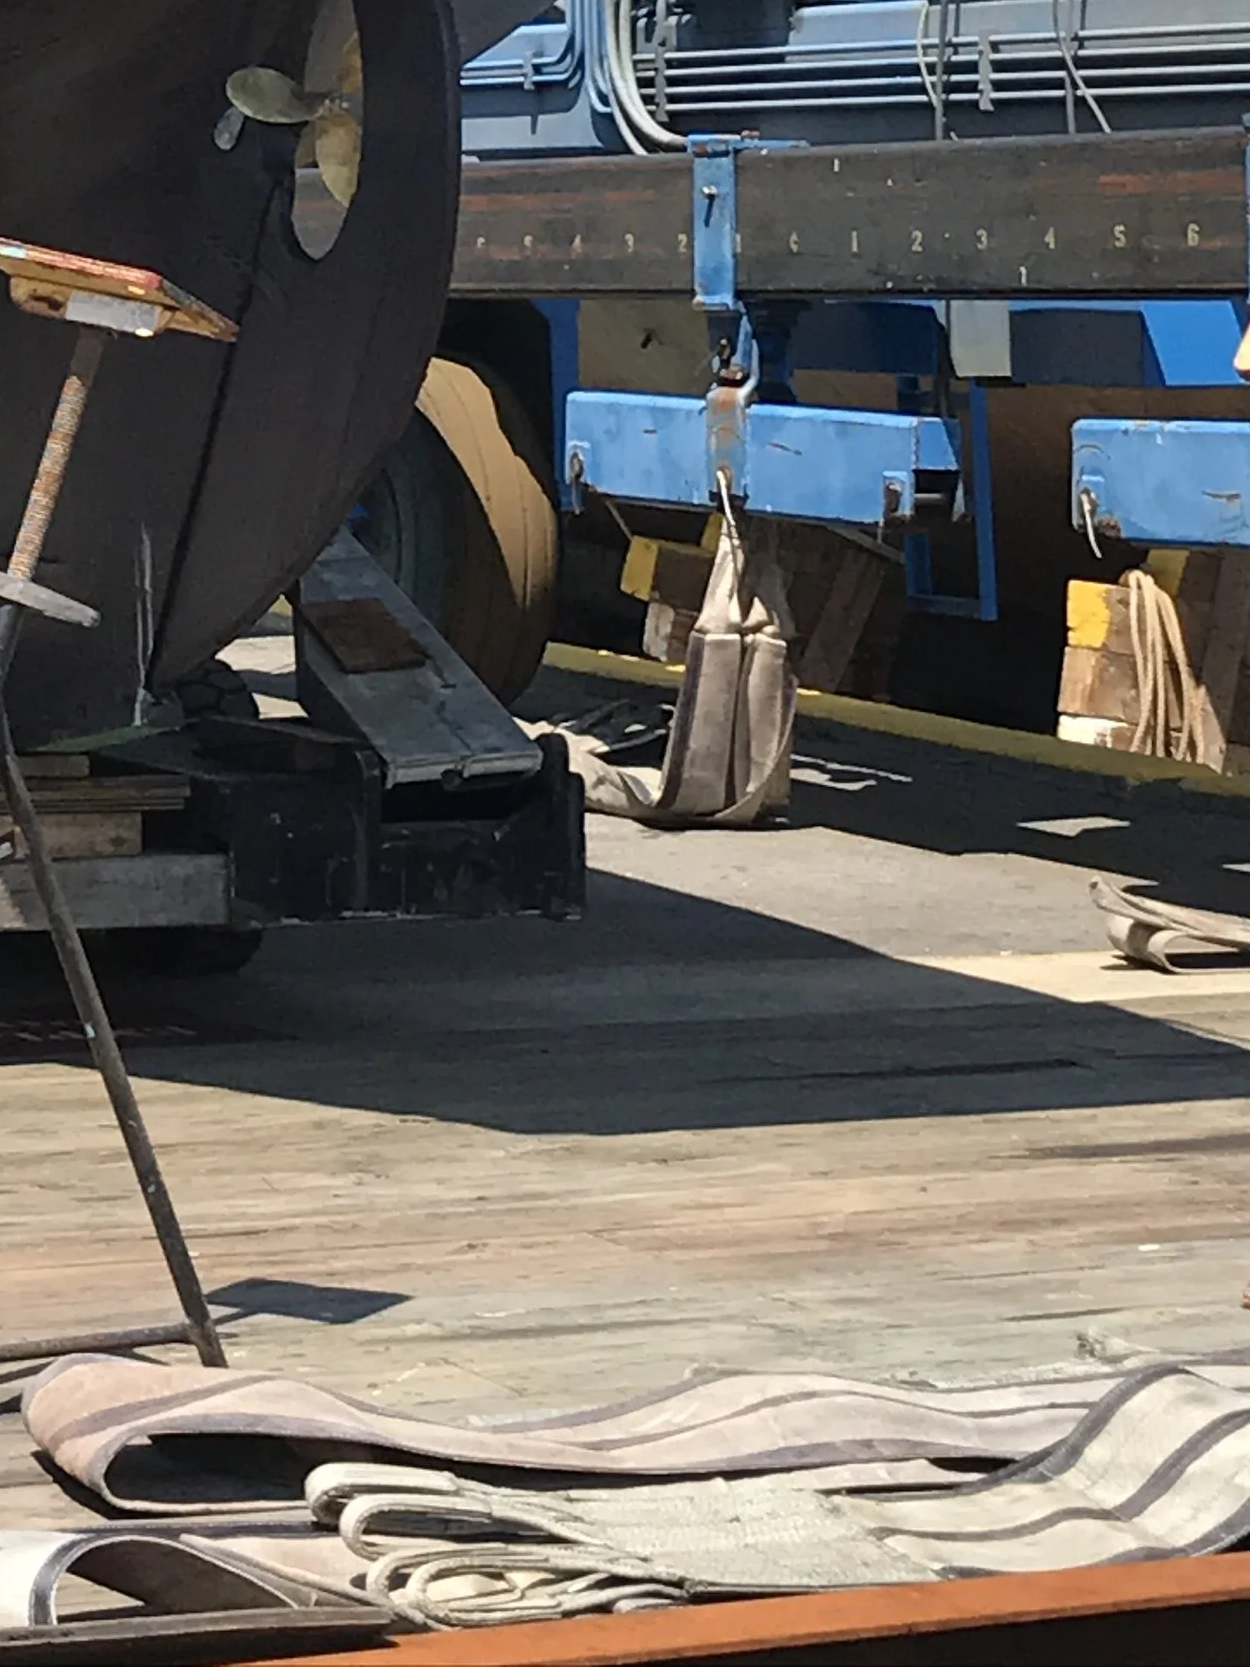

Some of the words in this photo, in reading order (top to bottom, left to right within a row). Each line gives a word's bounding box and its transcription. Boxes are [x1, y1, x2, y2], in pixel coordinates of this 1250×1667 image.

[851, 231, 859, 253] 1
[910, 230, 924, 252] 2
[975, 228, 988, 250] 3
[1043, 227, 1056, 250] 4
[1113, 224, 1127, 248] 5
[1186, 223, 1200, 247] 6
